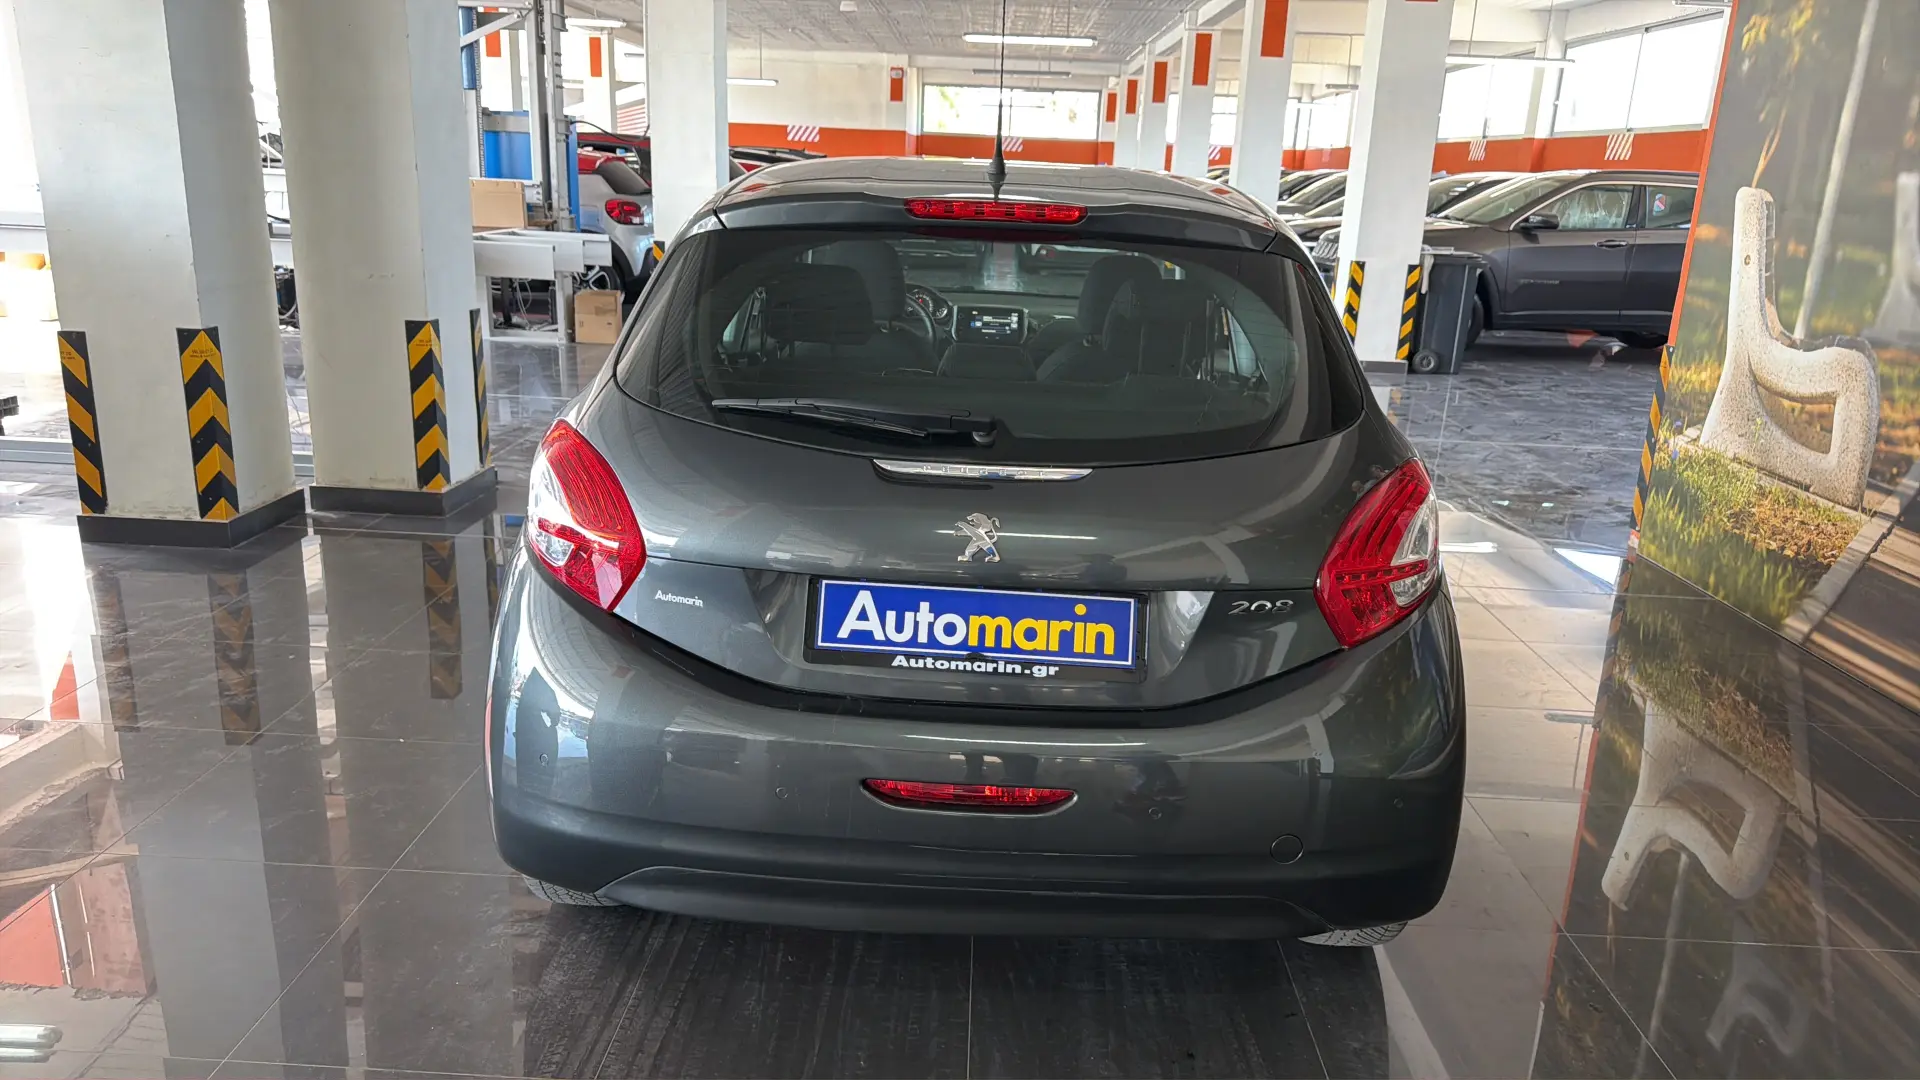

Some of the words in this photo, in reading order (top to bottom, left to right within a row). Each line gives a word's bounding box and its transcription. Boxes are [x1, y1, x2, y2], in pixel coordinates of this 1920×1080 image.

[655, 589, 703, 607] Automarin
[1228, 599, 1294, 615] 208
[836, 589, 1115, 655] Automarin
[891, 654, 1059, 678] Automarin.gr
